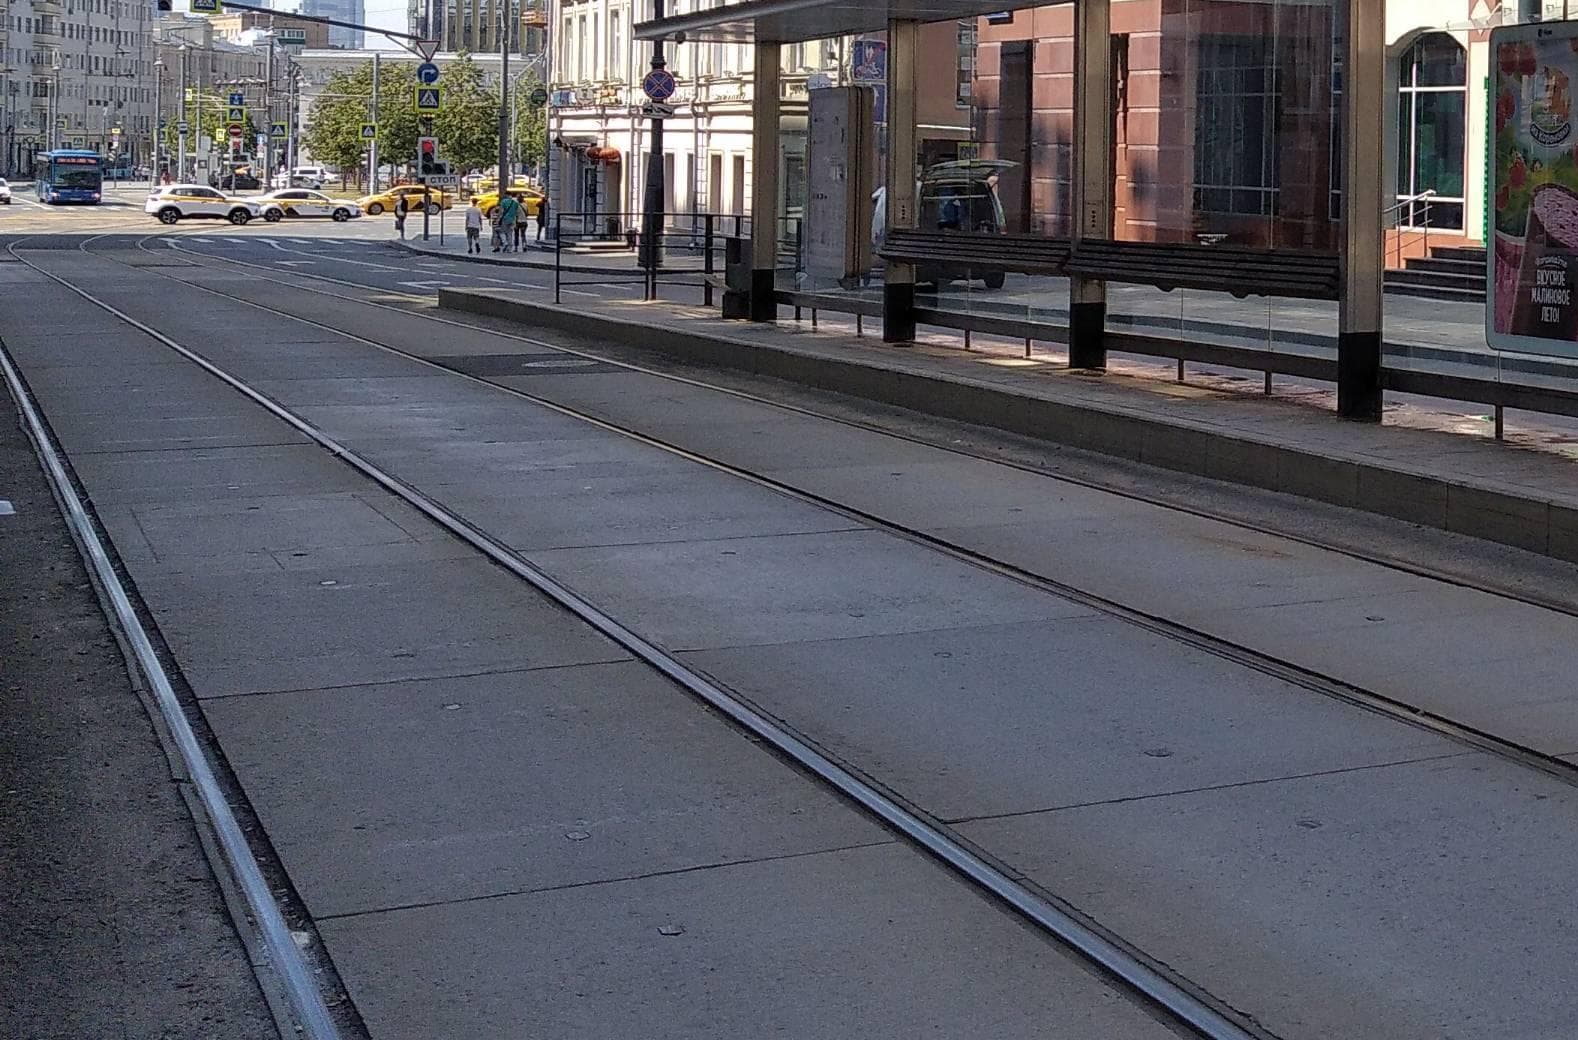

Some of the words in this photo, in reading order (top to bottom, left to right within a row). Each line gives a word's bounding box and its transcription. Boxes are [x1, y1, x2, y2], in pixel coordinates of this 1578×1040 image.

[1537, 269, 1566, 286] ВКУСНОЕ
[1531, 288, 1570, 305] МАЛИНОВОЕ
[1541, 307, 1559, 323] ЛЕТО!
